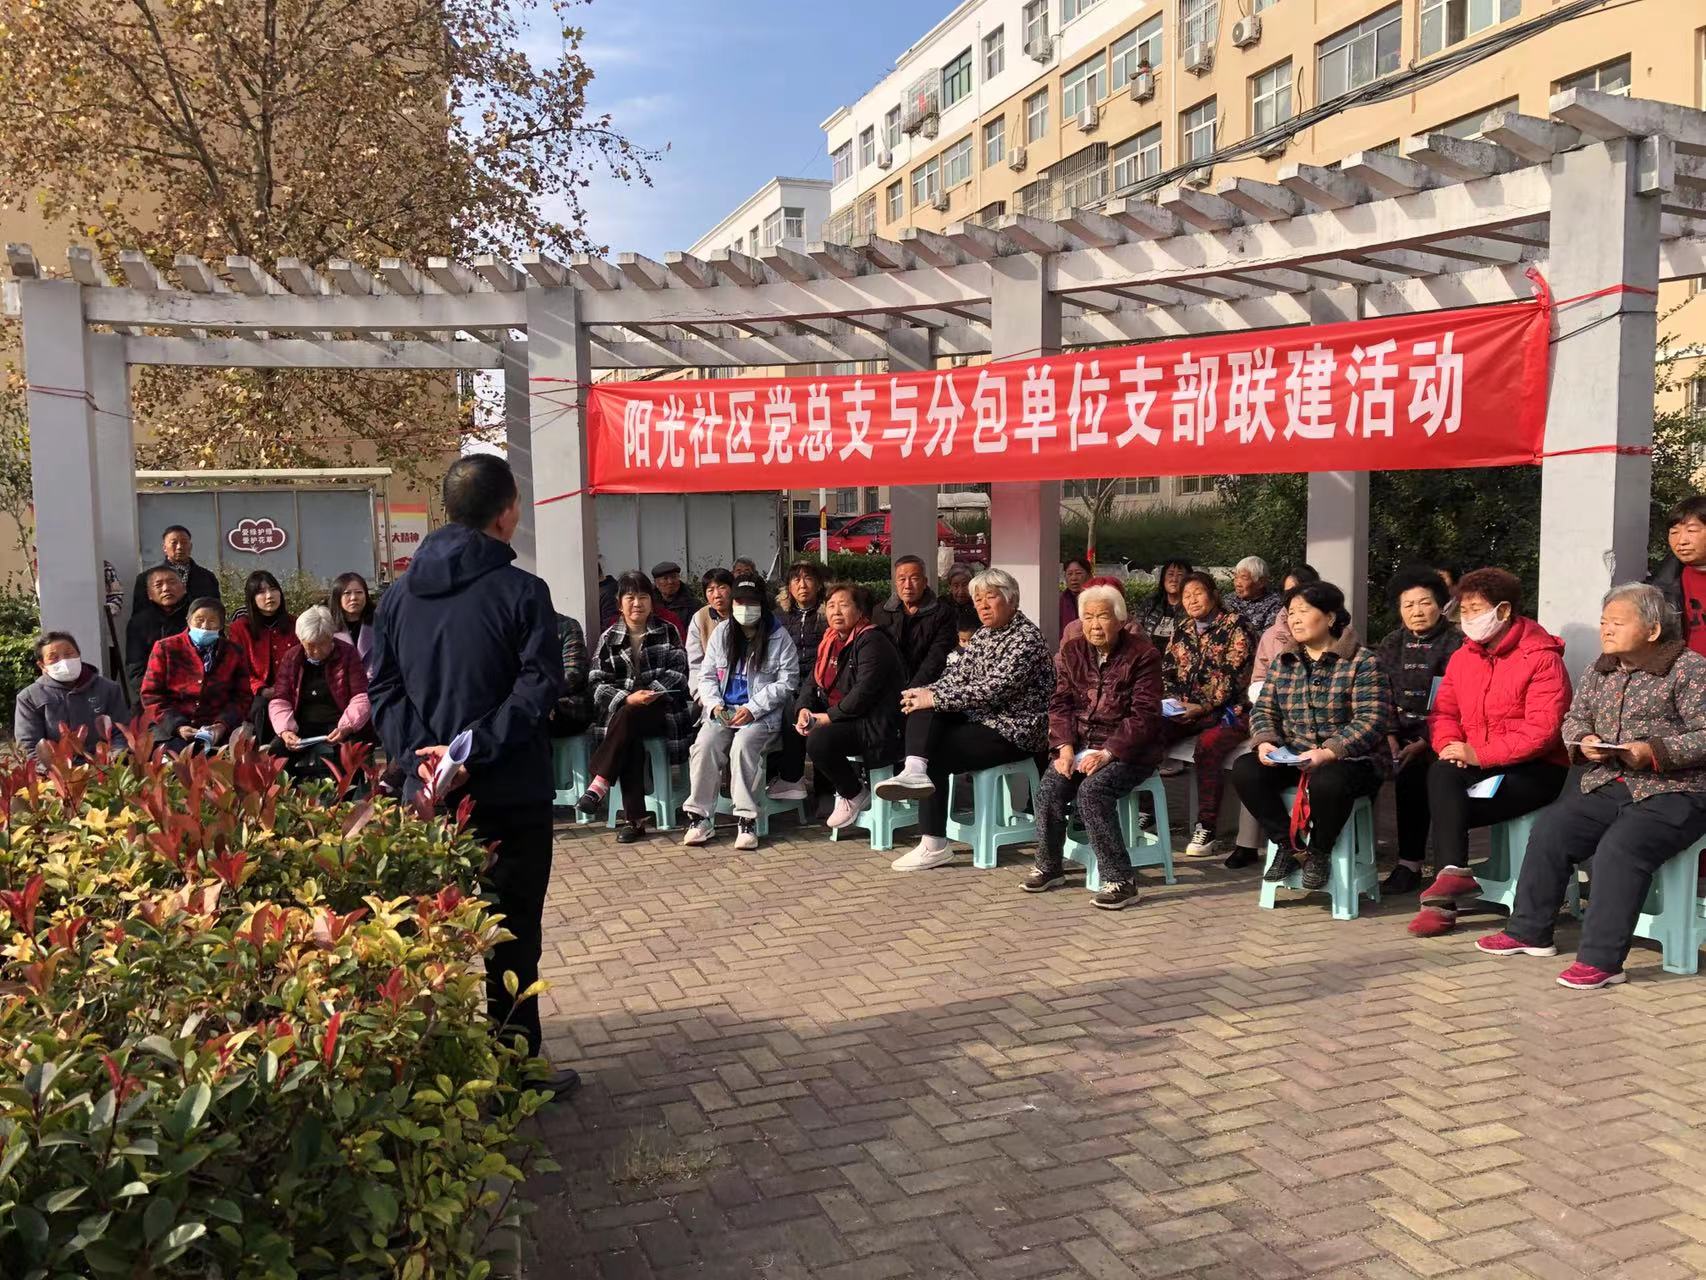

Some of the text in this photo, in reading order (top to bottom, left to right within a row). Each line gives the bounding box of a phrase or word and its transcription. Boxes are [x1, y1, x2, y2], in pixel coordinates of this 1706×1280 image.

[623, 331, 1464, 470] 阳光社区党总支与分包单位支部联建活动
